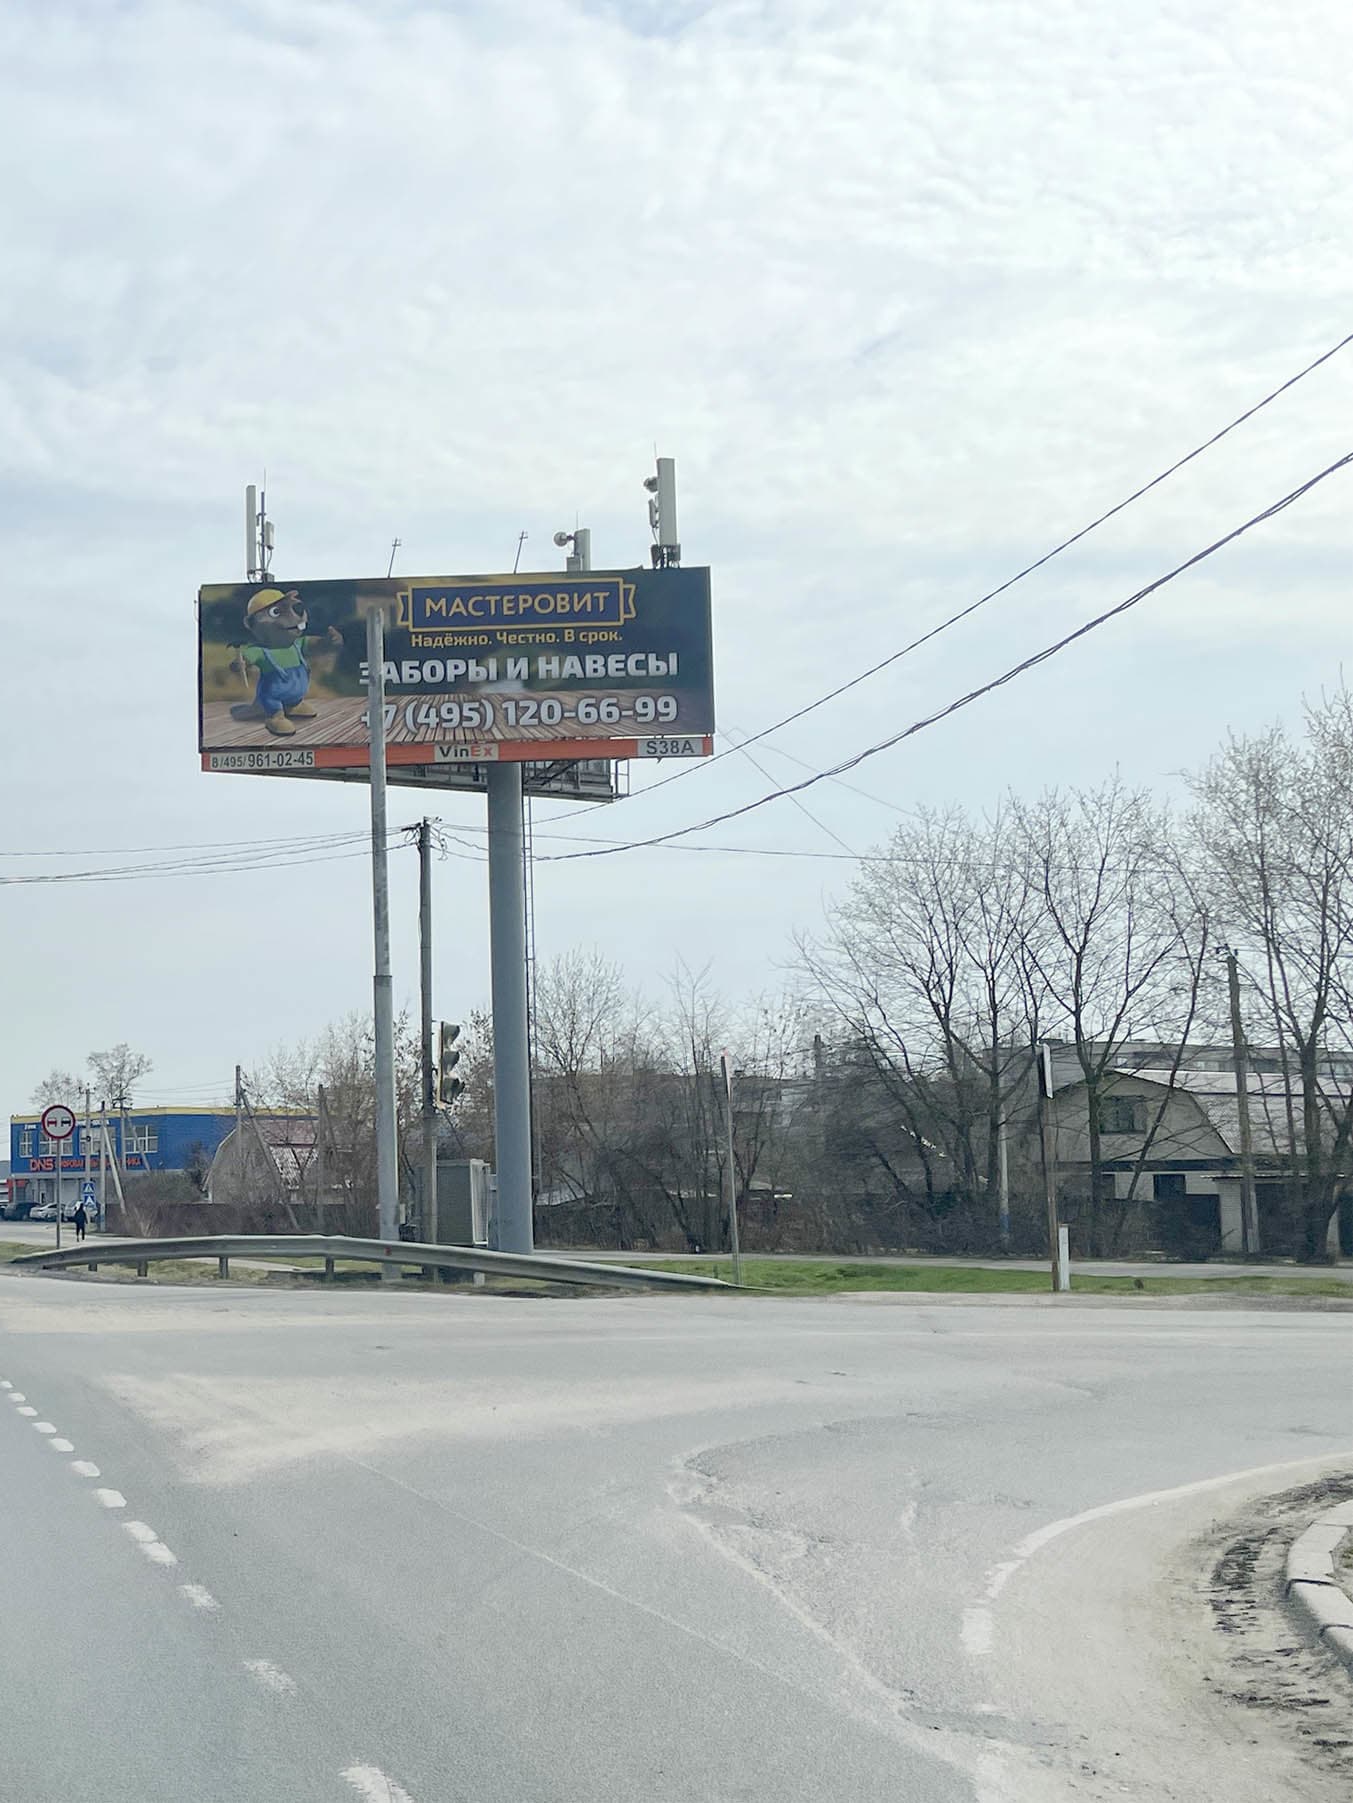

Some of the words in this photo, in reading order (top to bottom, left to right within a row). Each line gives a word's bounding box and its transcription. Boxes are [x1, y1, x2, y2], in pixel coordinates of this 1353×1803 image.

[425, 591, 610, 618] МАСТЕРОВИТ
[411, 632, 493, 648] Надёжно.
[497, 630, 560, 644] Честно.
[564, 629, 575, 642] В
[579, 629, 623, 644] срок.
[506, 656, 529, 681] И
[537, 652, 678, 680] НАВЕСЫ
[405, 699, 495, 732] (495)
[501, 695, 678, 727] 120-66-99
[439, 745, 492, 758] VinEx
[646, 740, 695, 755] S38A
[30, 1159, 54, 1171] DNS
